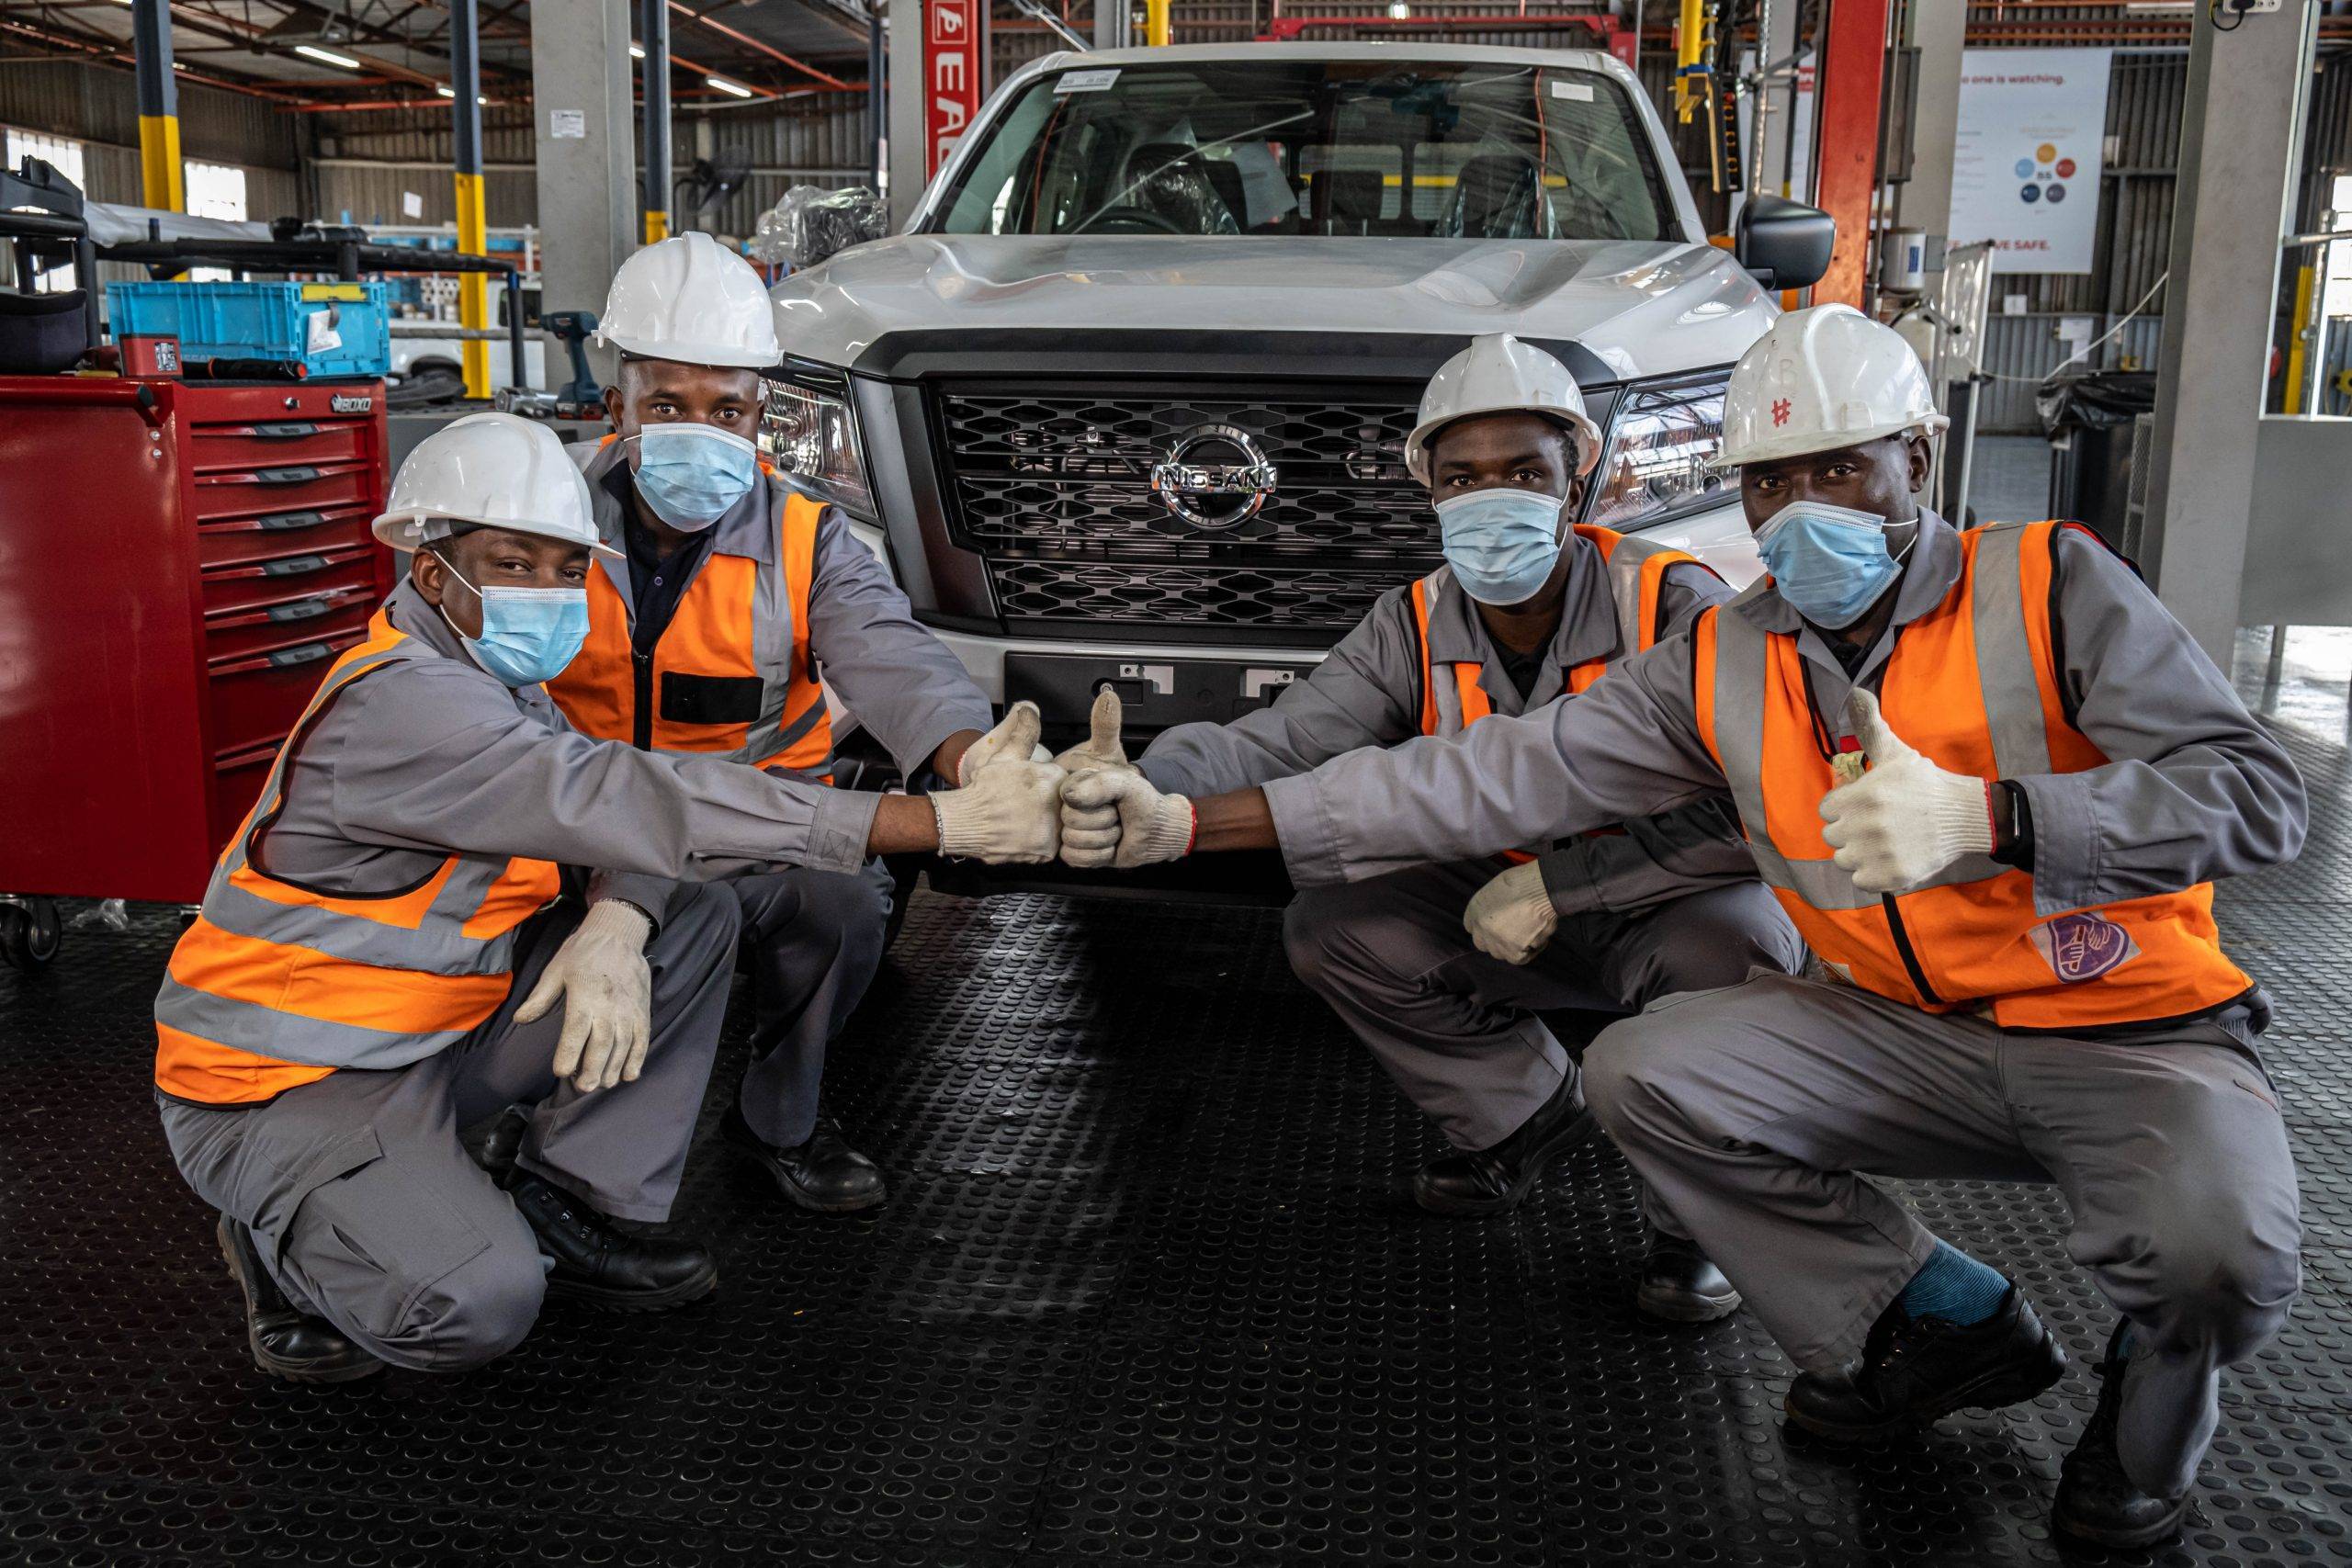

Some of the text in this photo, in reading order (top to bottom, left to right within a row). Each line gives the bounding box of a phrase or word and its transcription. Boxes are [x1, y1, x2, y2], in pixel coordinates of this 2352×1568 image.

[1972, 75, 1994, 84] one
[1996, 73, 2006, 84] is
[2008, 73, 2066, 85] watching.
[1164, 468, 1263, 489] NISSAN
